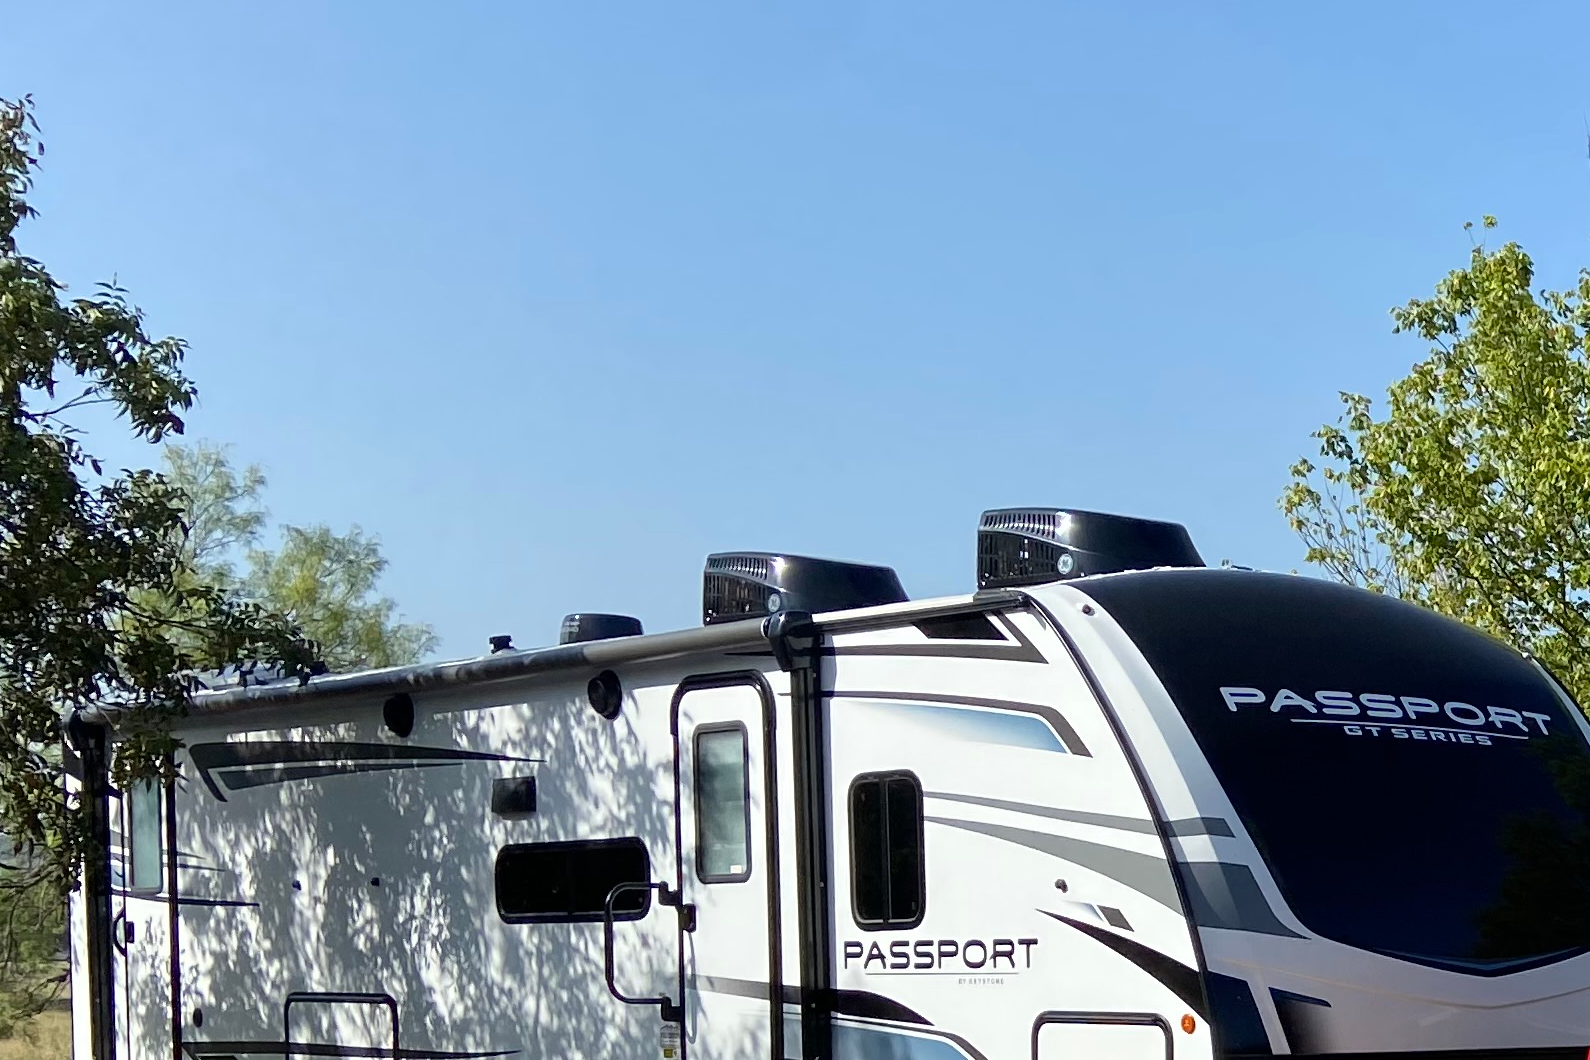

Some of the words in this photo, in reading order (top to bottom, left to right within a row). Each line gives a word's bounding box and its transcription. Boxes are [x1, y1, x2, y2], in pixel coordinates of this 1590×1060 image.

[1219, 686, 1551, 736] PASSPORT
[1343, 725, 1381, 737] GT
[1391, 728, 1492, 746] SERIES
[843, 938, 1039, 970] PASSPORT
